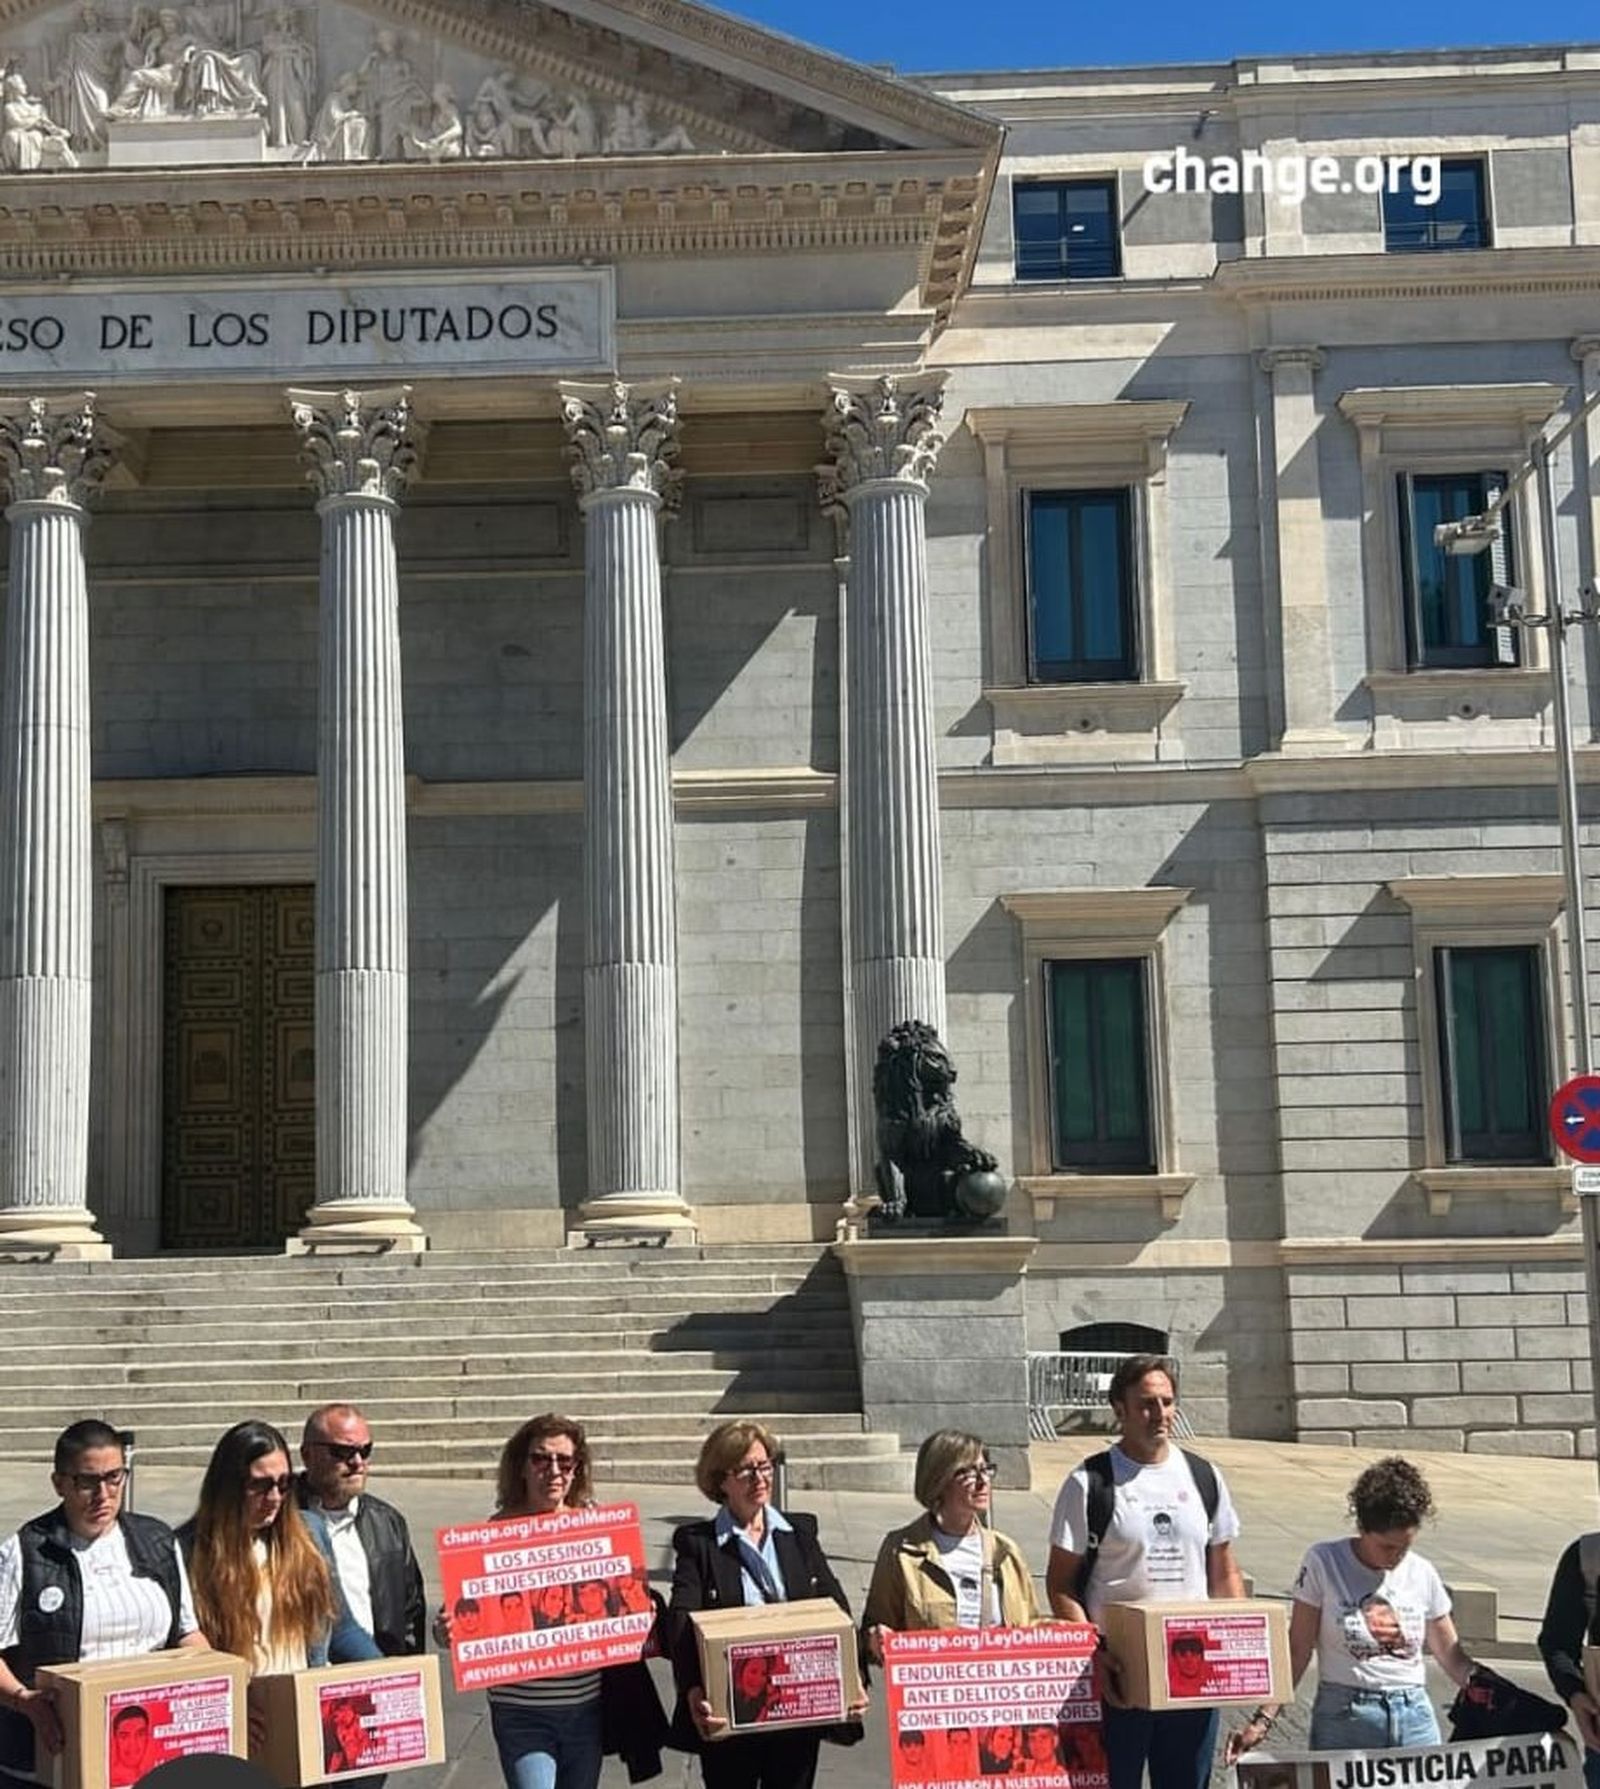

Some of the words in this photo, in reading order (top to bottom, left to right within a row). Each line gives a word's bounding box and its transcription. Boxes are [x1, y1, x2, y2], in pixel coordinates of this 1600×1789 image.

[0, 316, 64, 351] SO
[100, 314, 153, 350] DE
[188, 313, 270, 348] LOS
[306, 304, 559, 346] DIPUTADOS
[443, 1507, 632, 1546] change.org/LeyDelMenor
[492, 1552, 523, 1570] LOS
[527, 1540, 605, 1565] ASESINOS
[468, 1580, 490, 1596] DE
[494, 1567, 578, 1592] NUESTROS
[581, 1559, 627, 1578] HIJOS
[527, 1632, 549, 1649] LO
[551, 1626, 585, 1646] QUE
[890, 1628, 1091, 1651] change.org/LeyDelMenor
[519, 1658, 537, 1674] YA
[538, 1655, 556, 1669] LA
[557, 1652, 579, 1667] LEY
[581, 1648, 605, 1662] DEL
[897, 1661, 997, 1681] ENDURECER
[1001, 1660, 1031, 1676] LAS
[1036, 1658, 1091, 1675] PENAS
[907, 1688, 949, 1705] ANTE
[953, 1686, 1020, 1703] DELITOS
[1024, 1682, 1087, 1699] GRAVES
[900, 1709, 988, 1727] COMETIDOS
[993, 1707, 1022, 1723] POR
[1027, 1704, 1099, 1721] MENORES
[1336, 1752, 1477, 1789] JUSTICIA
[1485, 1741, 1567, 1777] PARA
[993, 1776, 1002, 1789] A
[1004, 1774, 1070, 1789] NUESTROS
[1071, 1772, 1108, 1787] HIJOS
